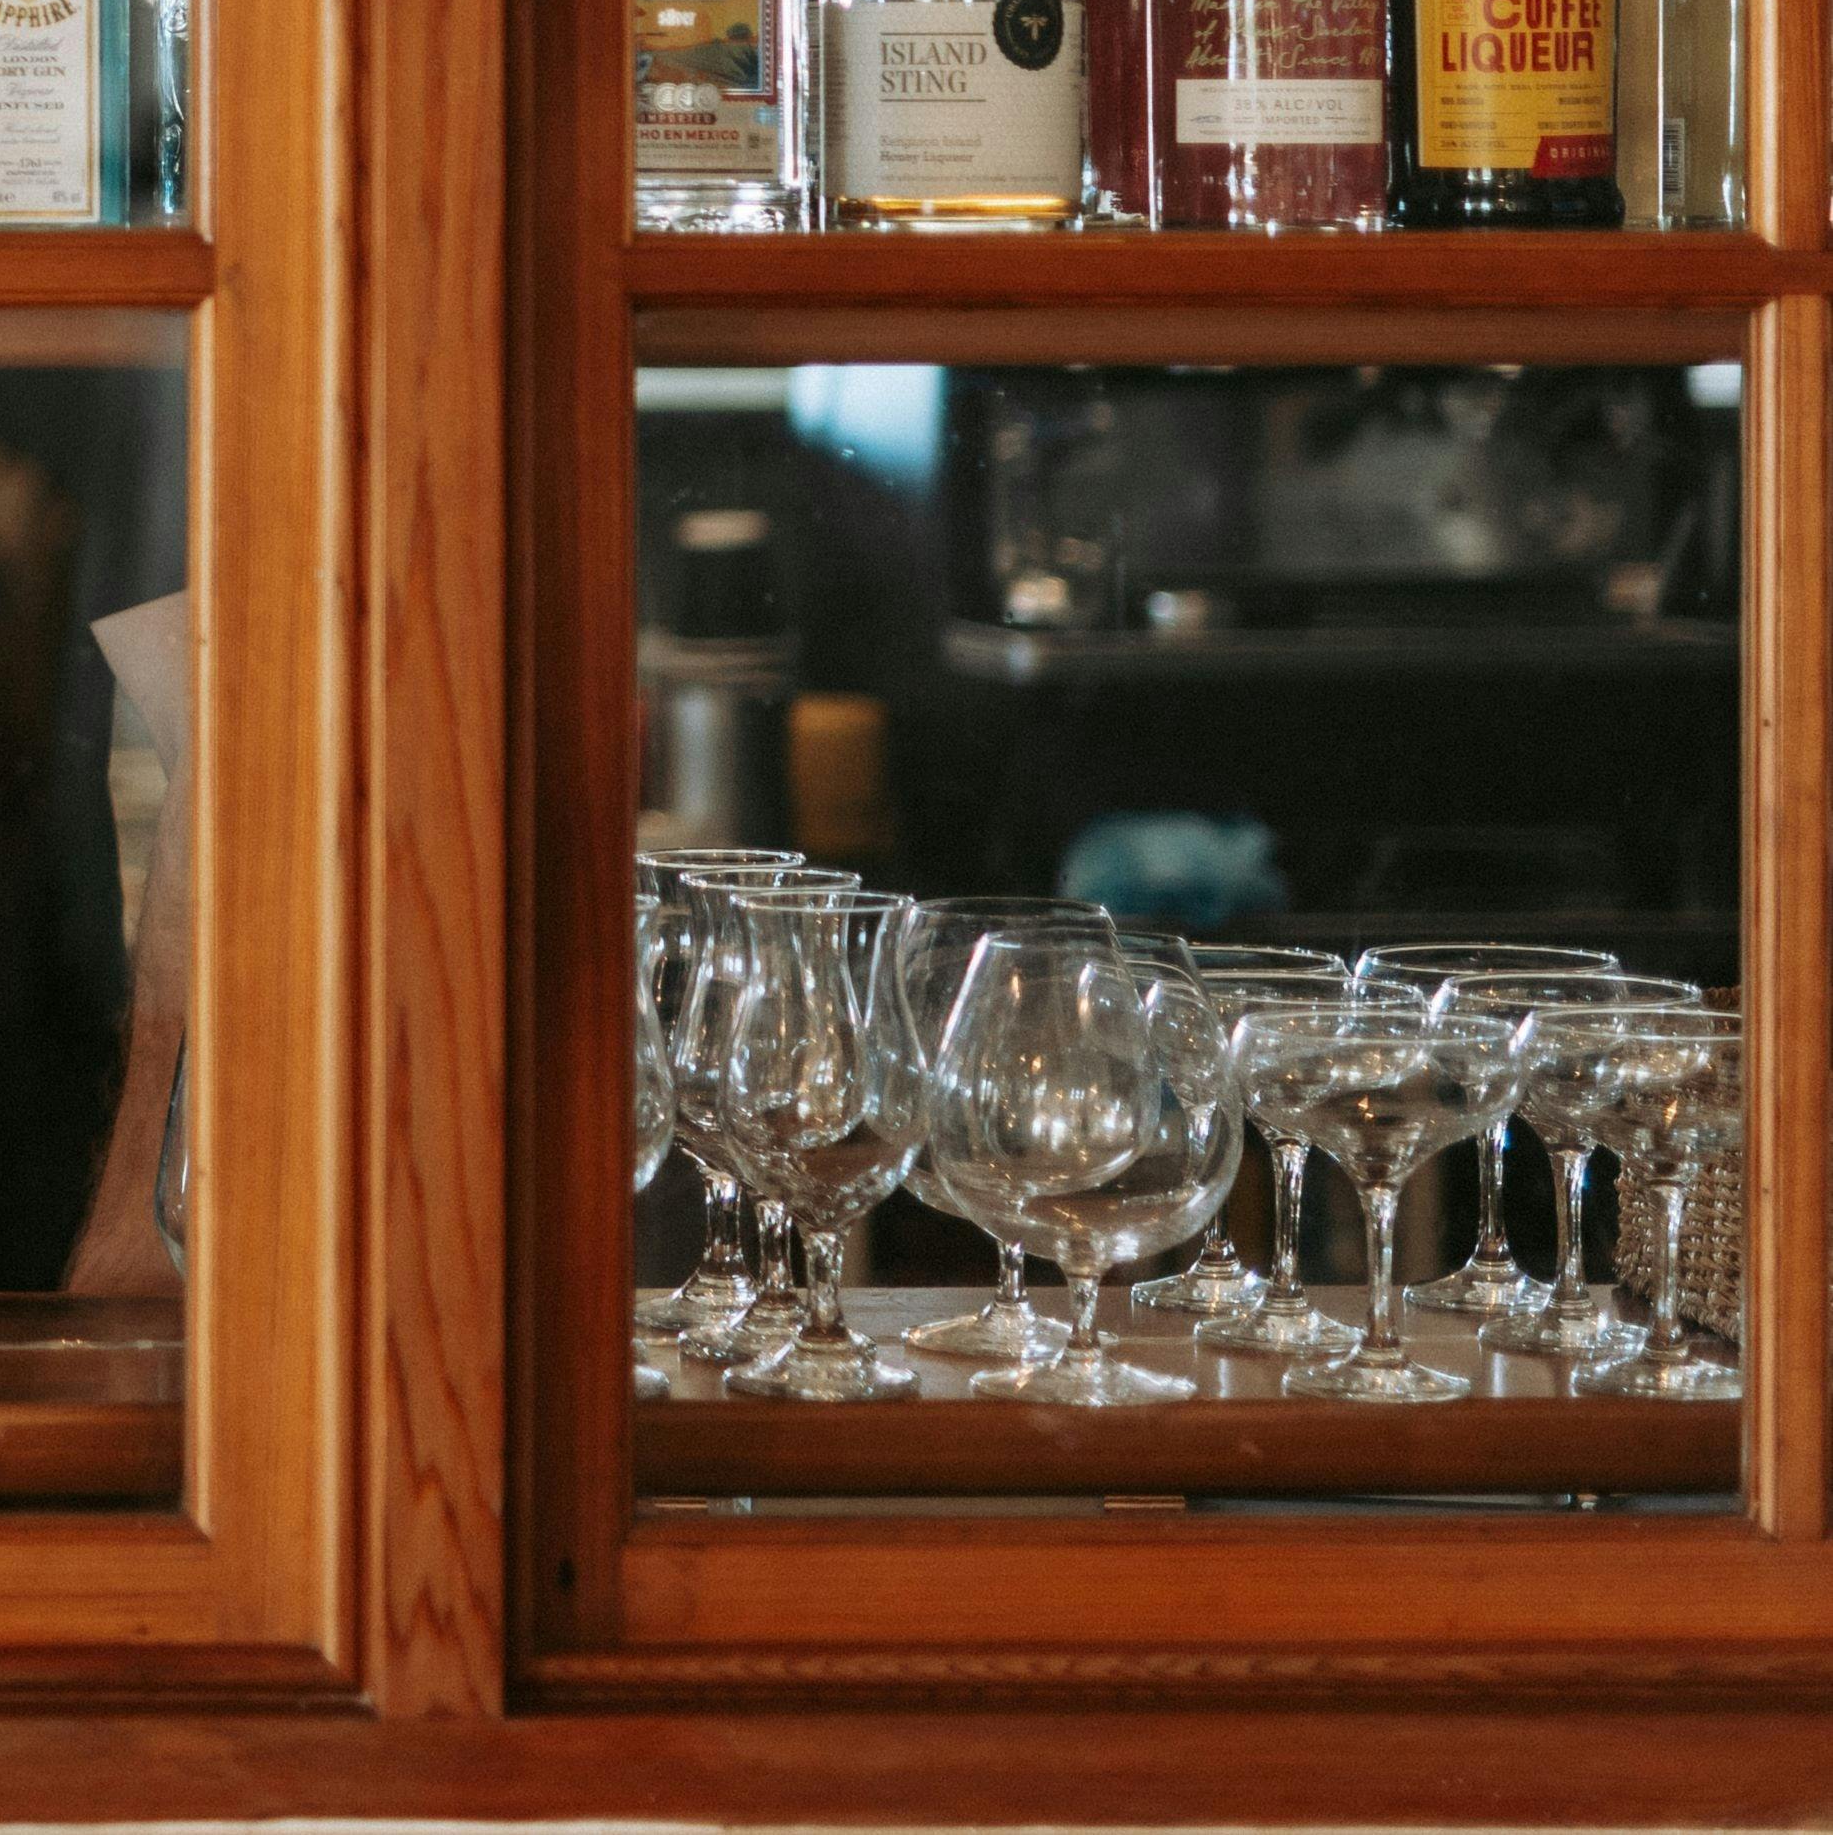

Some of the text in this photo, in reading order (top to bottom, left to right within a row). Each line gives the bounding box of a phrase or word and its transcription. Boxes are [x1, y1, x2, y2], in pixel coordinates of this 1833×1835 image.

[881, 41, 988, 66] ISLAND
[1441, 31, 1596, 74] LIQUEUR
[2, 55, 59, 64] LONDON
[32, 66, 67, 78] GIN
[881, 70, 968, 94] STING
[666, 130, 740, 141] EN MEXICO
[1549, 146, 1611, 159] ORIGINA
